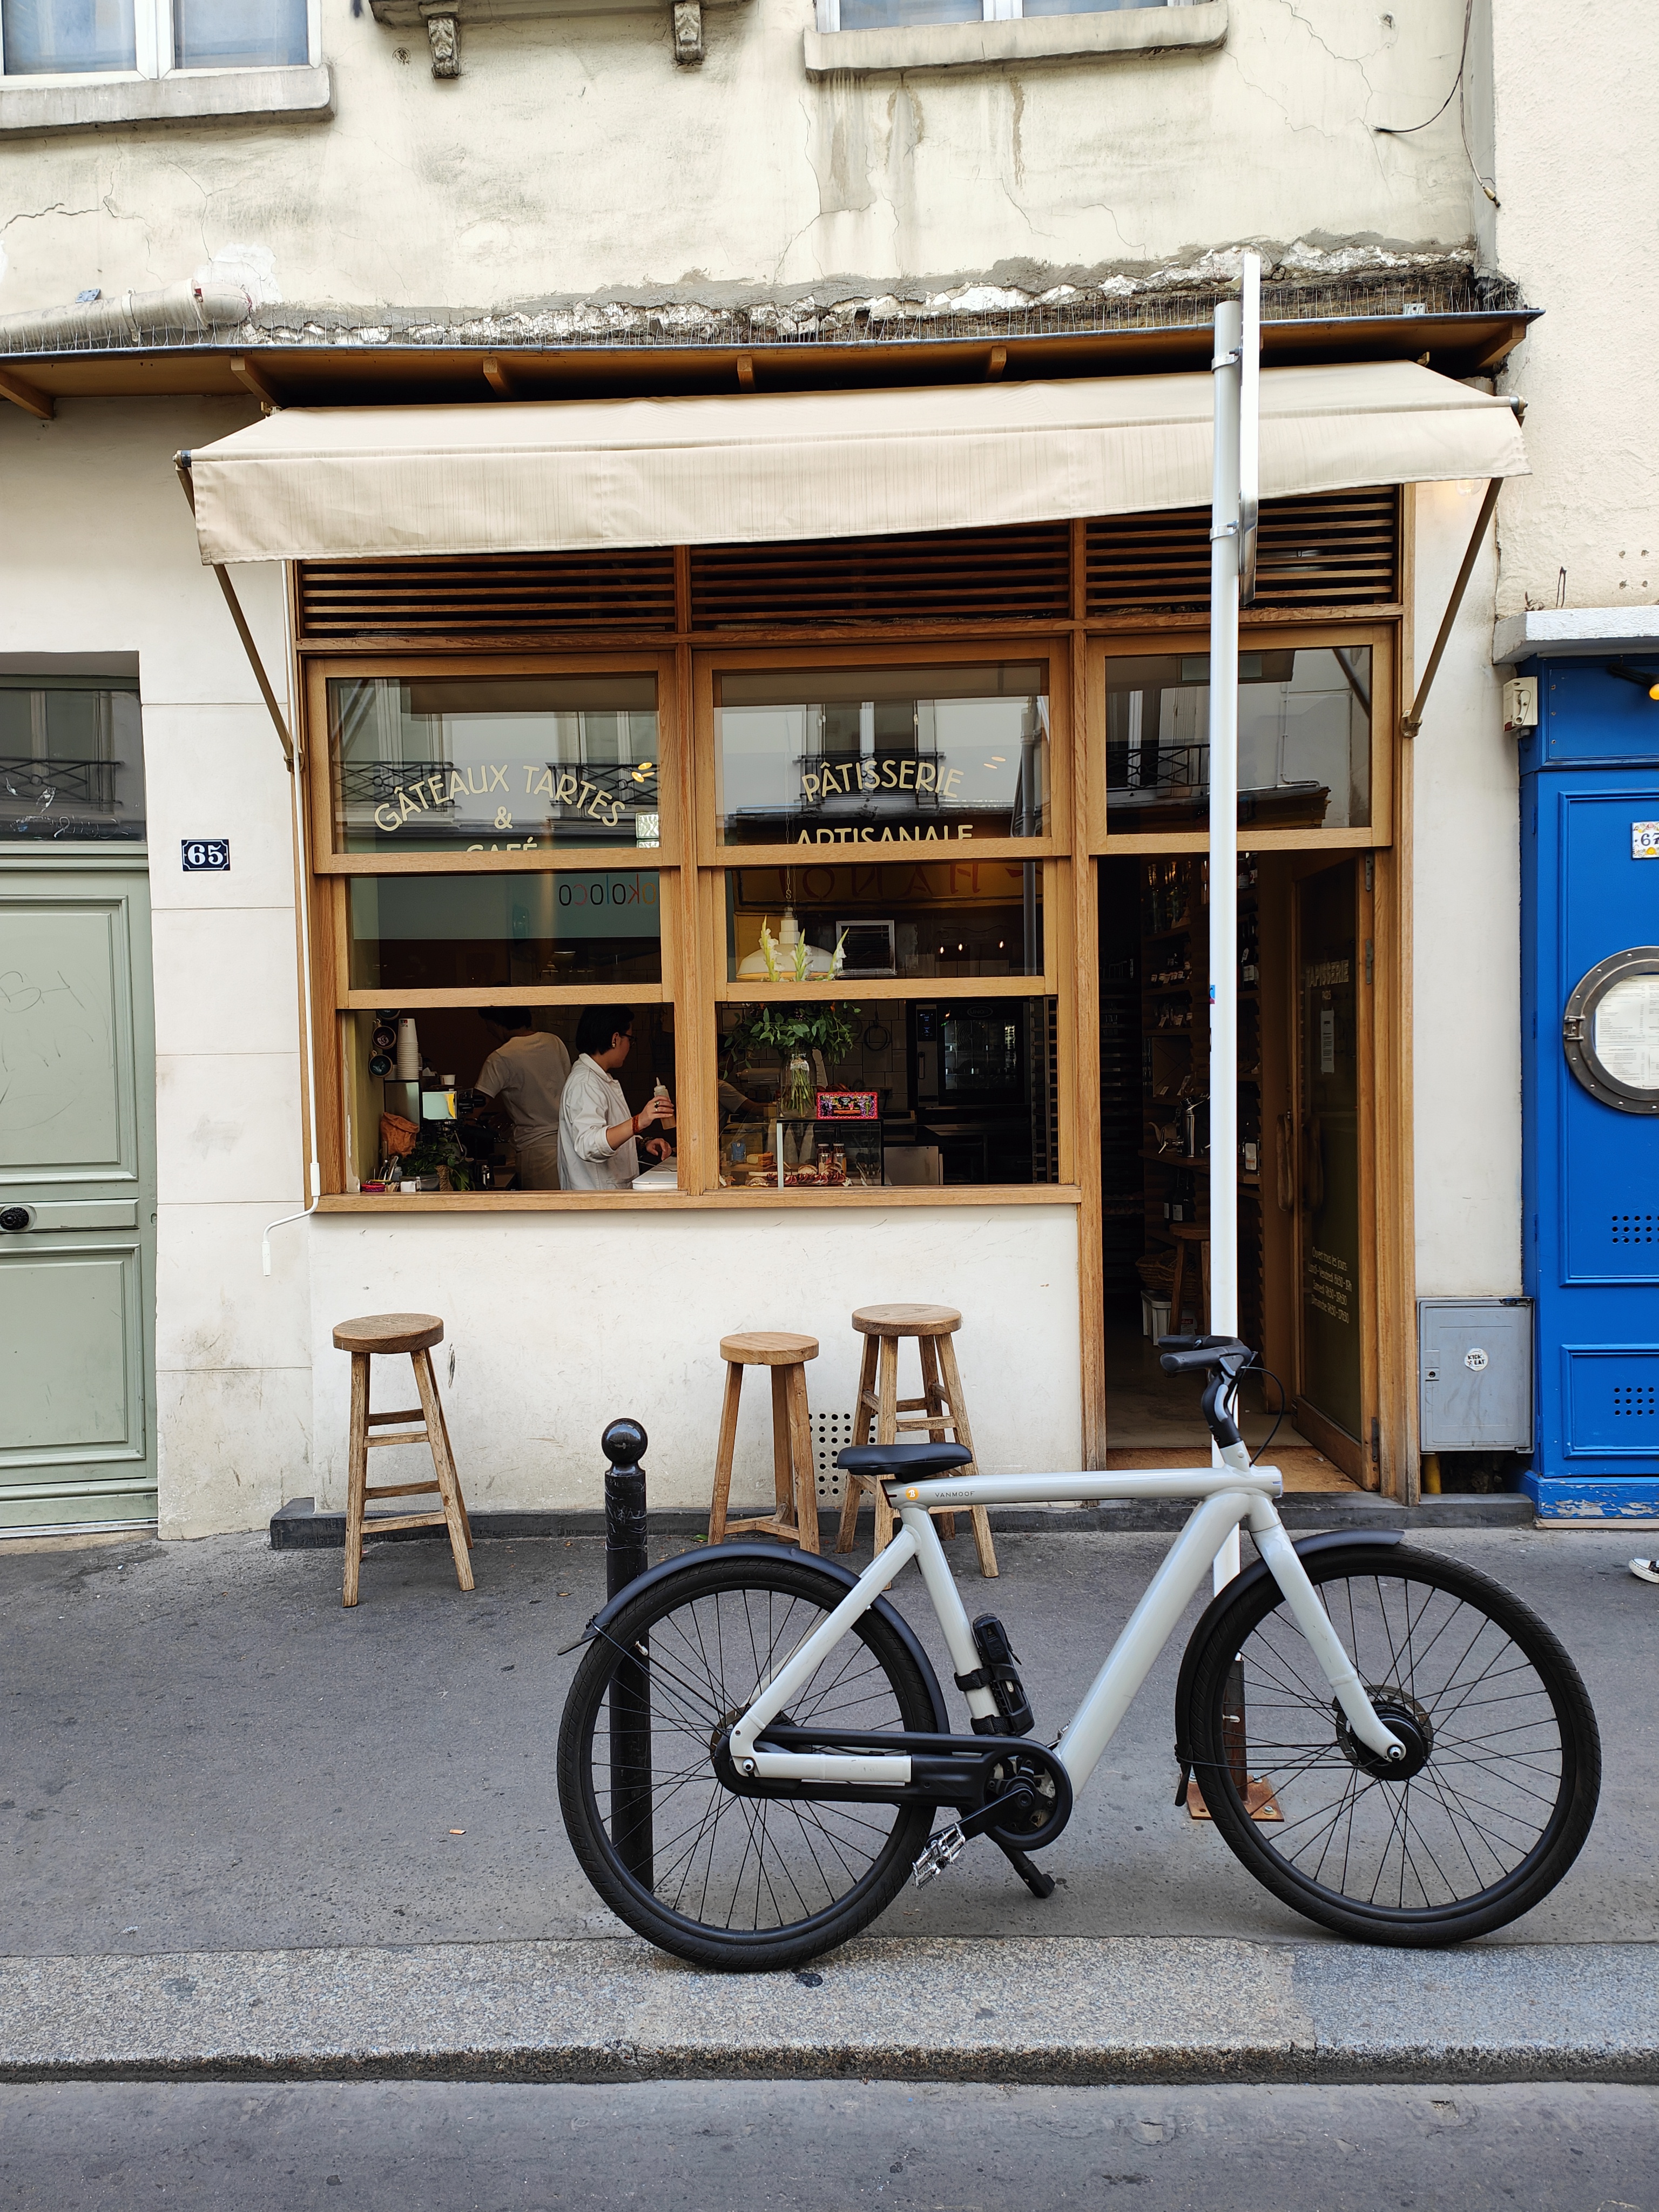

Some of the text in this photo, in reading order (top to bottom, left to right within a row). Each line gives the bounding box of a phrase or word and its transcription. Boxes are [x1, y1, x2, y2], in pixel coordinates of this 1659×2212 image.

[374, 764, 625, 831] GÂTEAUX TARTES
[801, 760, 964, 802] PÂTISSERIE
[494, 806, 513, 830] &
[187, 844, 224, 865] 65
